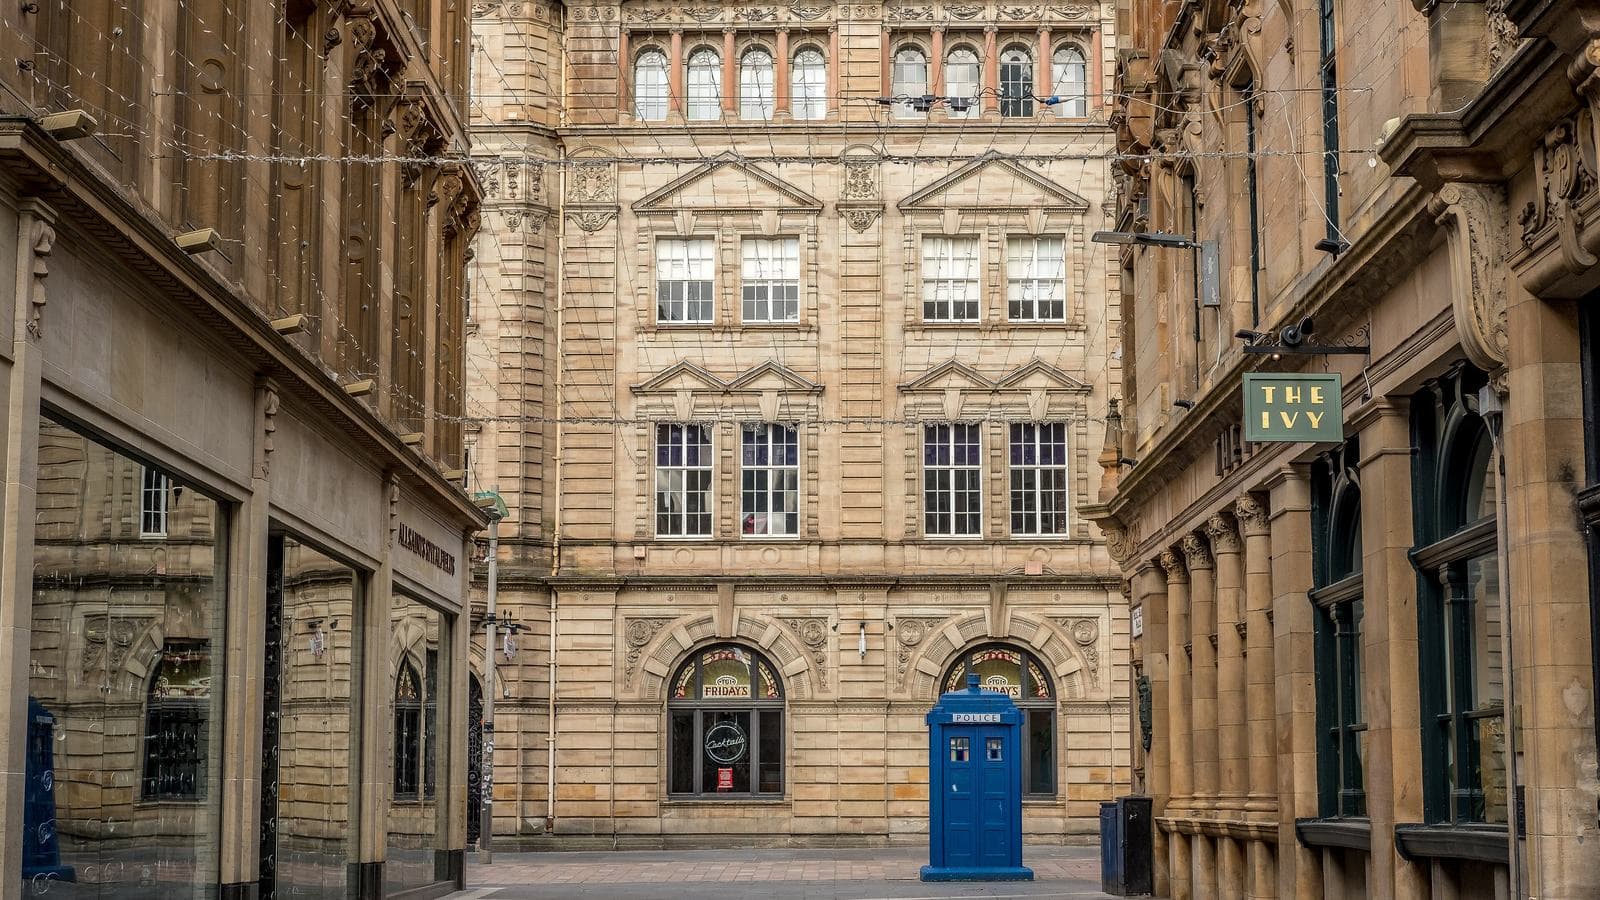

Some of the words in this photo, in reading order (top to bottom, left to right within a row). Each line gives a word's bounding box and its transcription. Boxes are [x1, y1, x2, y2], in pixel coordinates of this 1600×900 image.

[1261, 386, 1324, 404] THE
[1262, 411, 1324, 429] IVY
[705, 686, 748, 696] FRIDAY'S
[956, 714, 998, 722] POLICE
[705, 735, 745, 749] Cocktails
